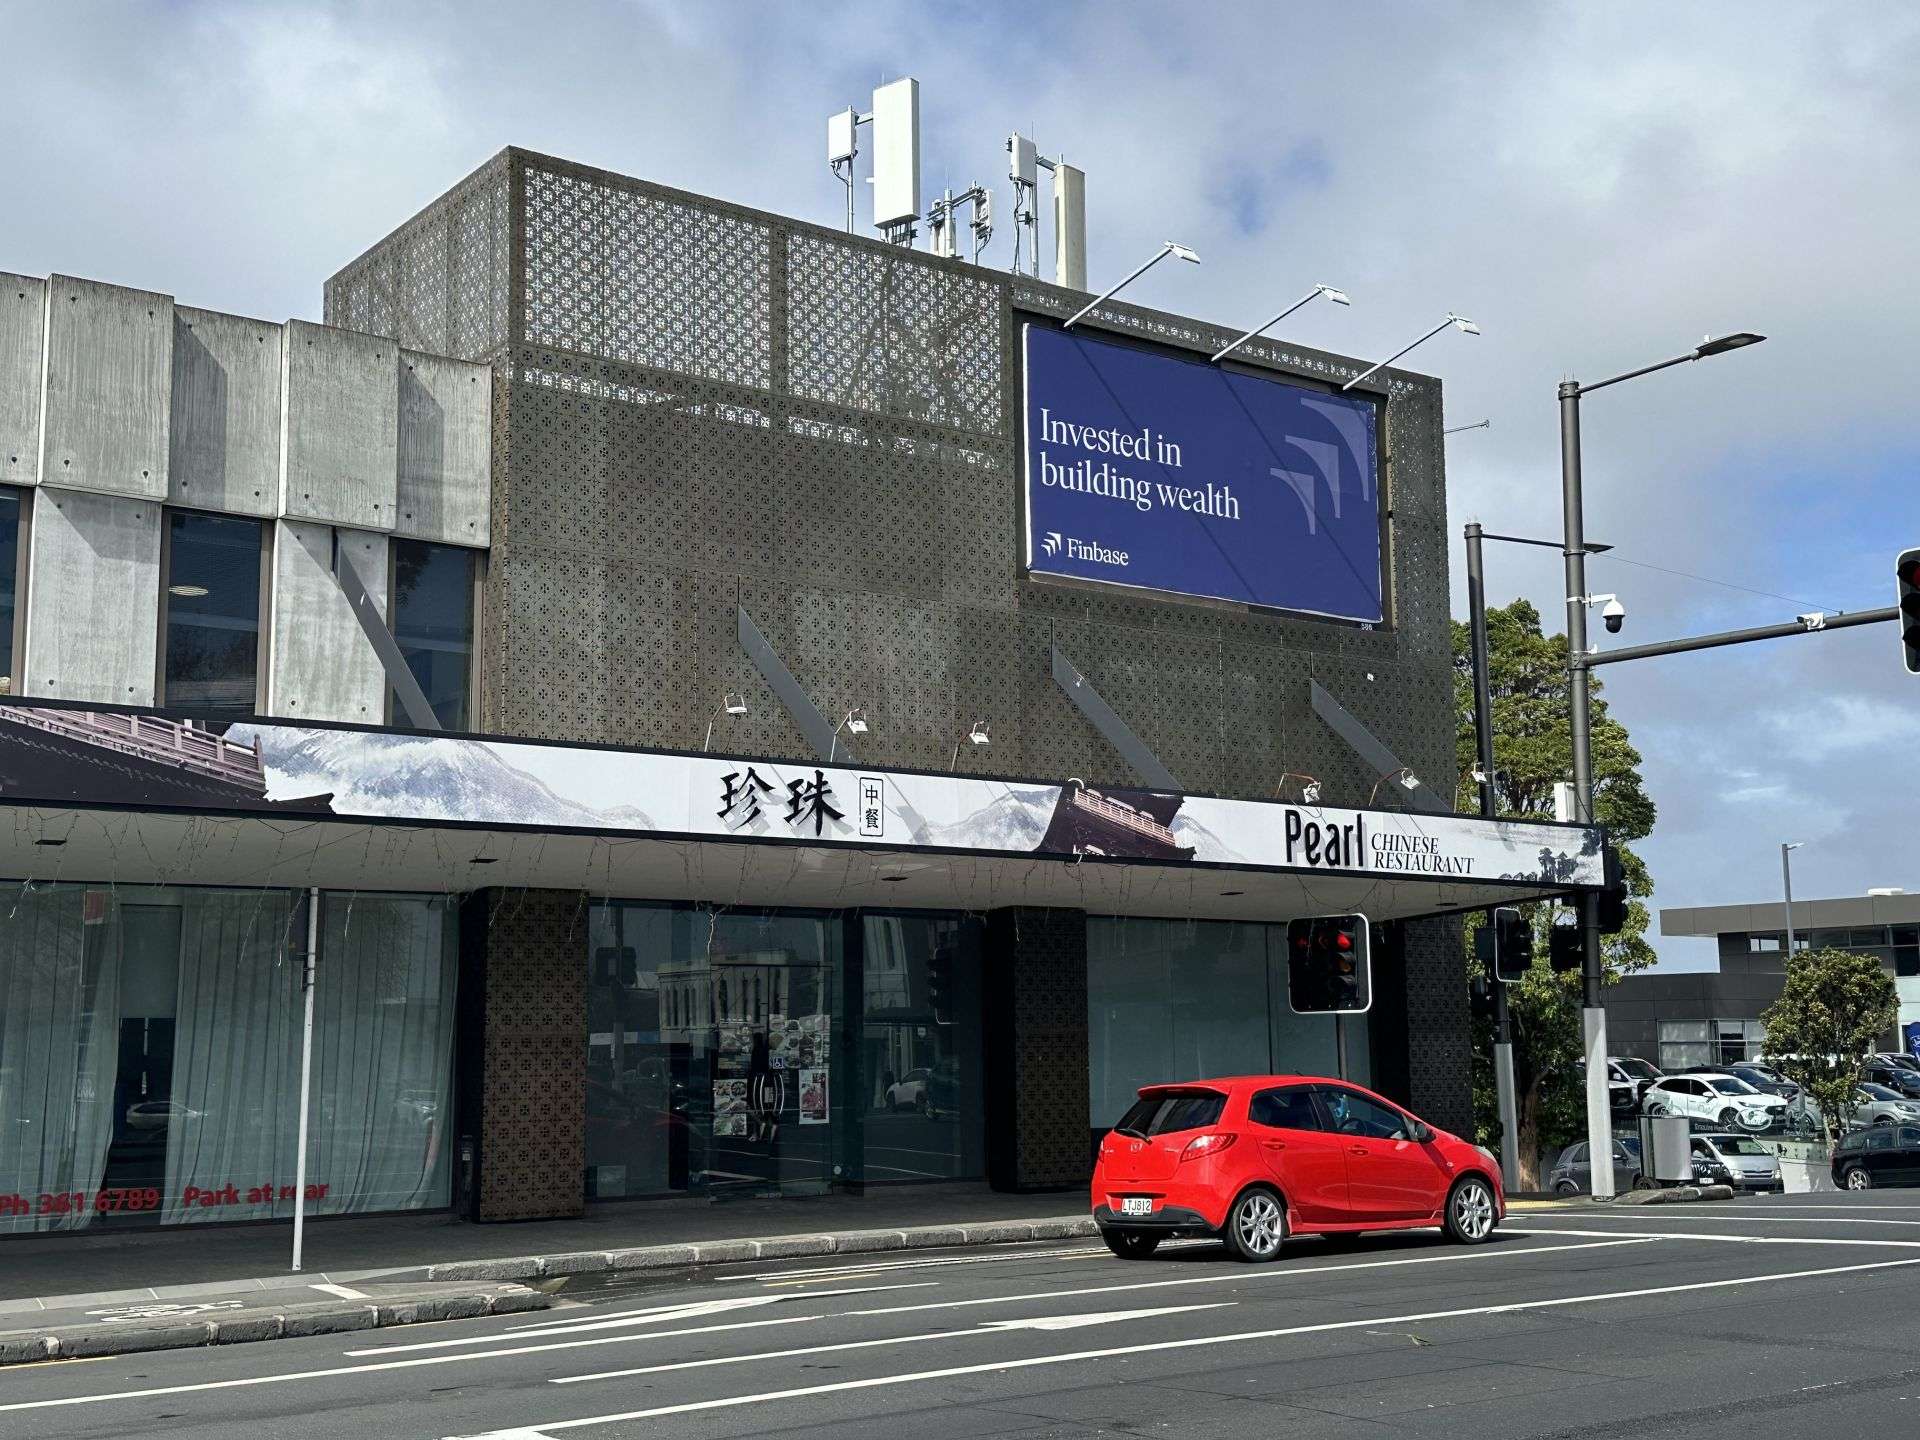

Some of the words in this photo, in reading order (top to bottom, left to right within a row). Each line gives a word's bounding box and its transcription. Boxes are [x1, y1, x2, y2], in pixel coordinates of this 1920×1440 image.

[1040, 407, 1151, 461] Invested
[1157, 434, 1183, 468] in
[1040, 452, 1152, 511] building
[1156, 483, 1241, 520] wealth
[1067, 537, 1129, 566] Finbase
[717, 766, 846, 837] 珍珠
[865, 784, 879, 829] 中餐
[1285, 809, 1364, 867] Pearl
[1371, 832, 1439, 854] CHINESE
[1375, 852, 1474, 874] RESTAURANT
[0, 1193, 30, 1216] Ph
[38, 1191, 85, 1214] 361
[95, 1186, 161, 1212] 6789
[183, 1183, 240, 1208] Park
[248, 1183, 273, 1204] at
